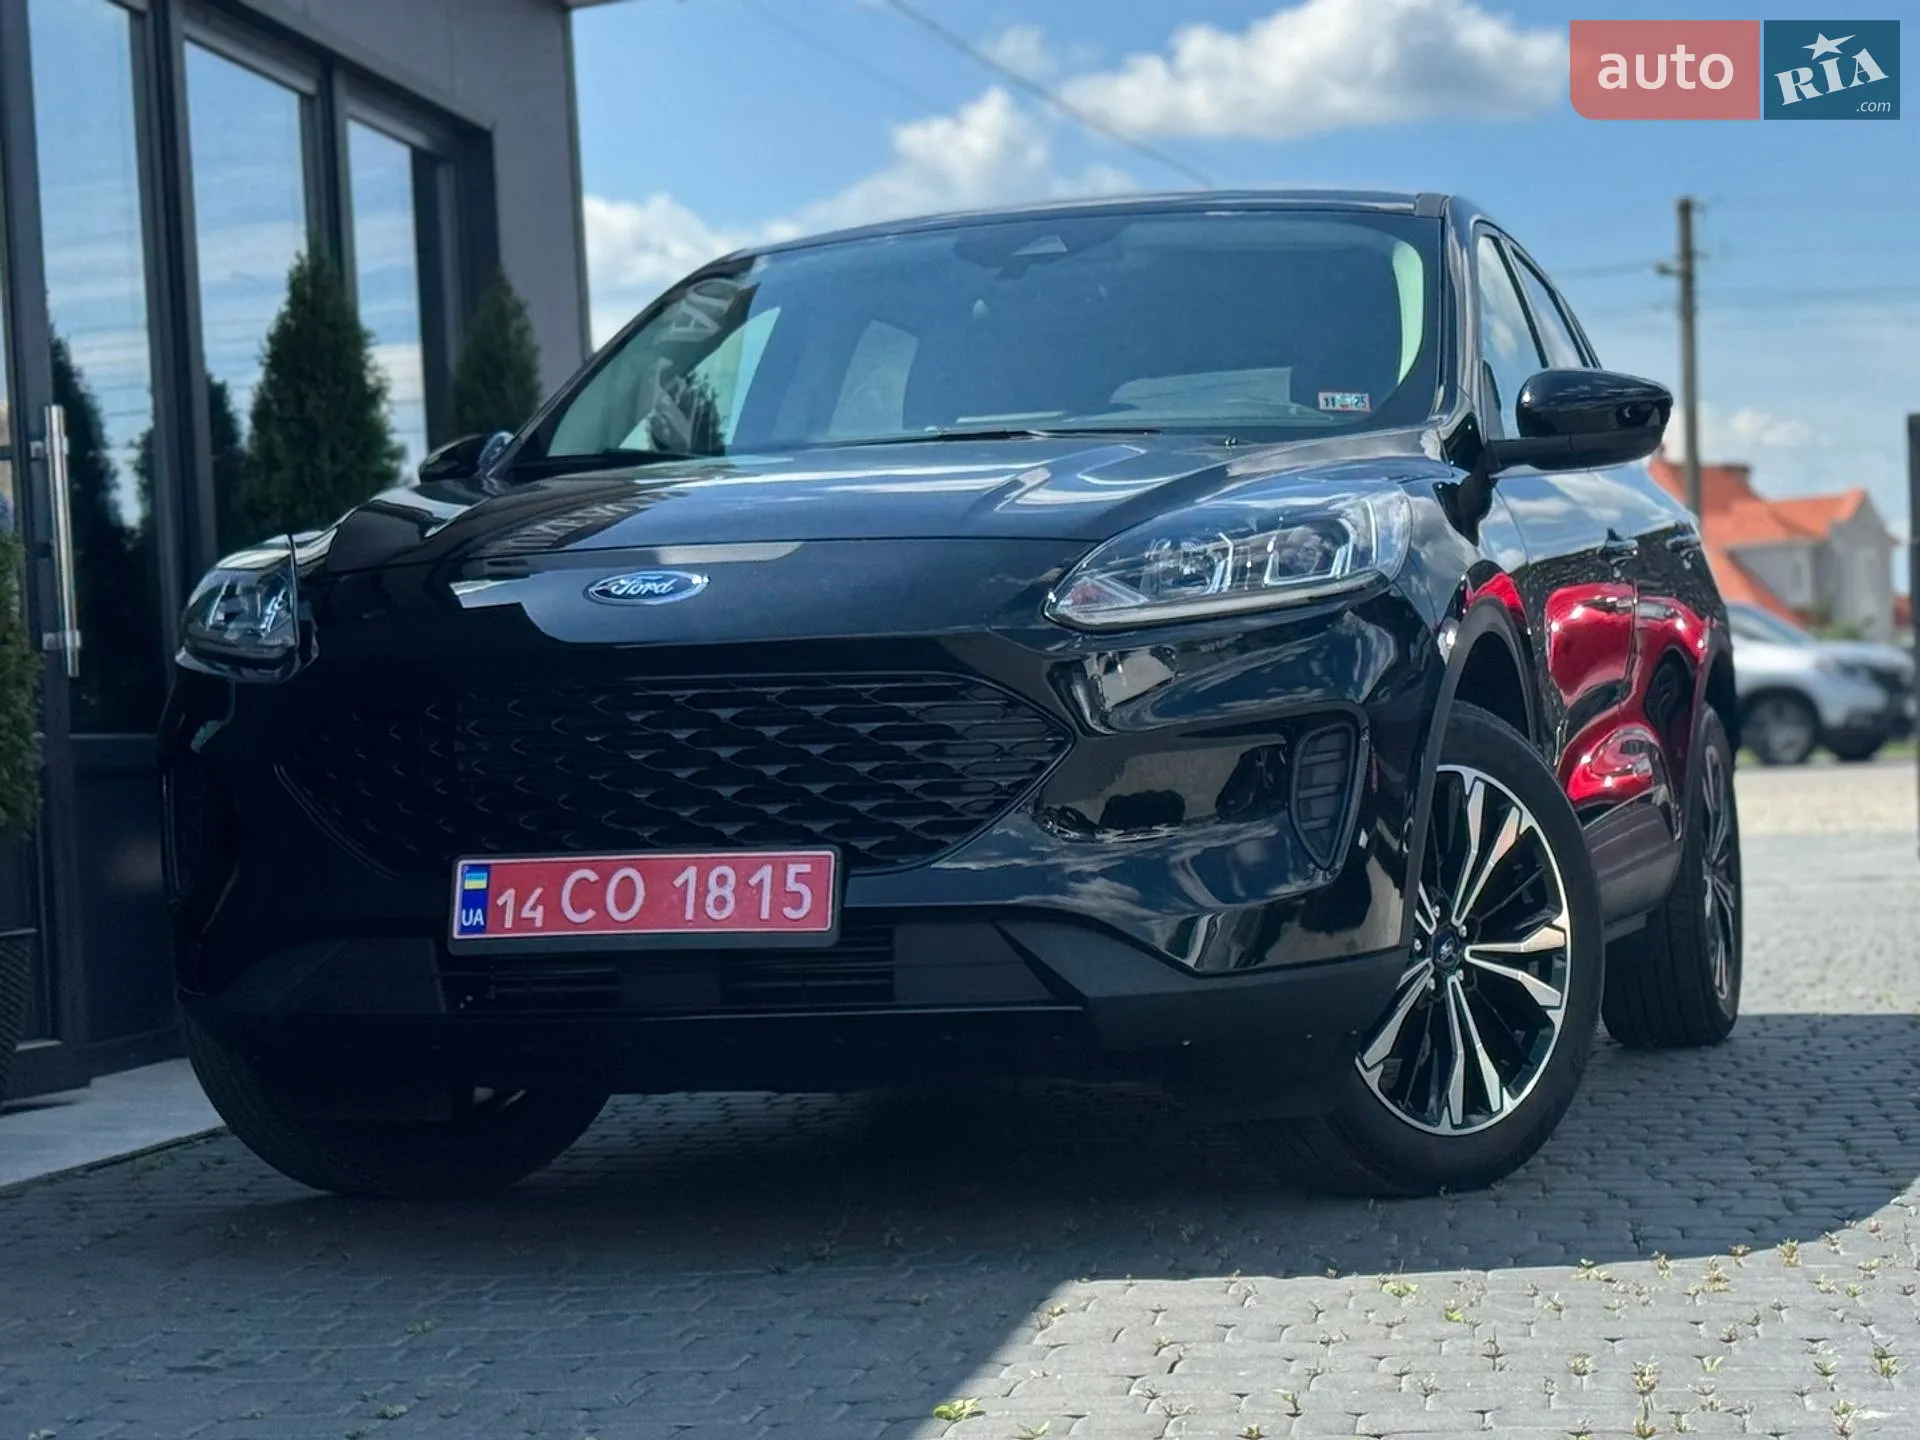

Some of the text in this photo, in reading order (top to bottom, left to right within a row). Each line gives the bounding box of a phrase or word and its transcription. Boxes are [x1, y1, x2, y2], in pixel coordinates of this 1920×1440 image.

[607, 577, 679, 596] Ford
[496, 864, 812, 928] 14 CO 1815
[461, 909, 484, 927] UA
